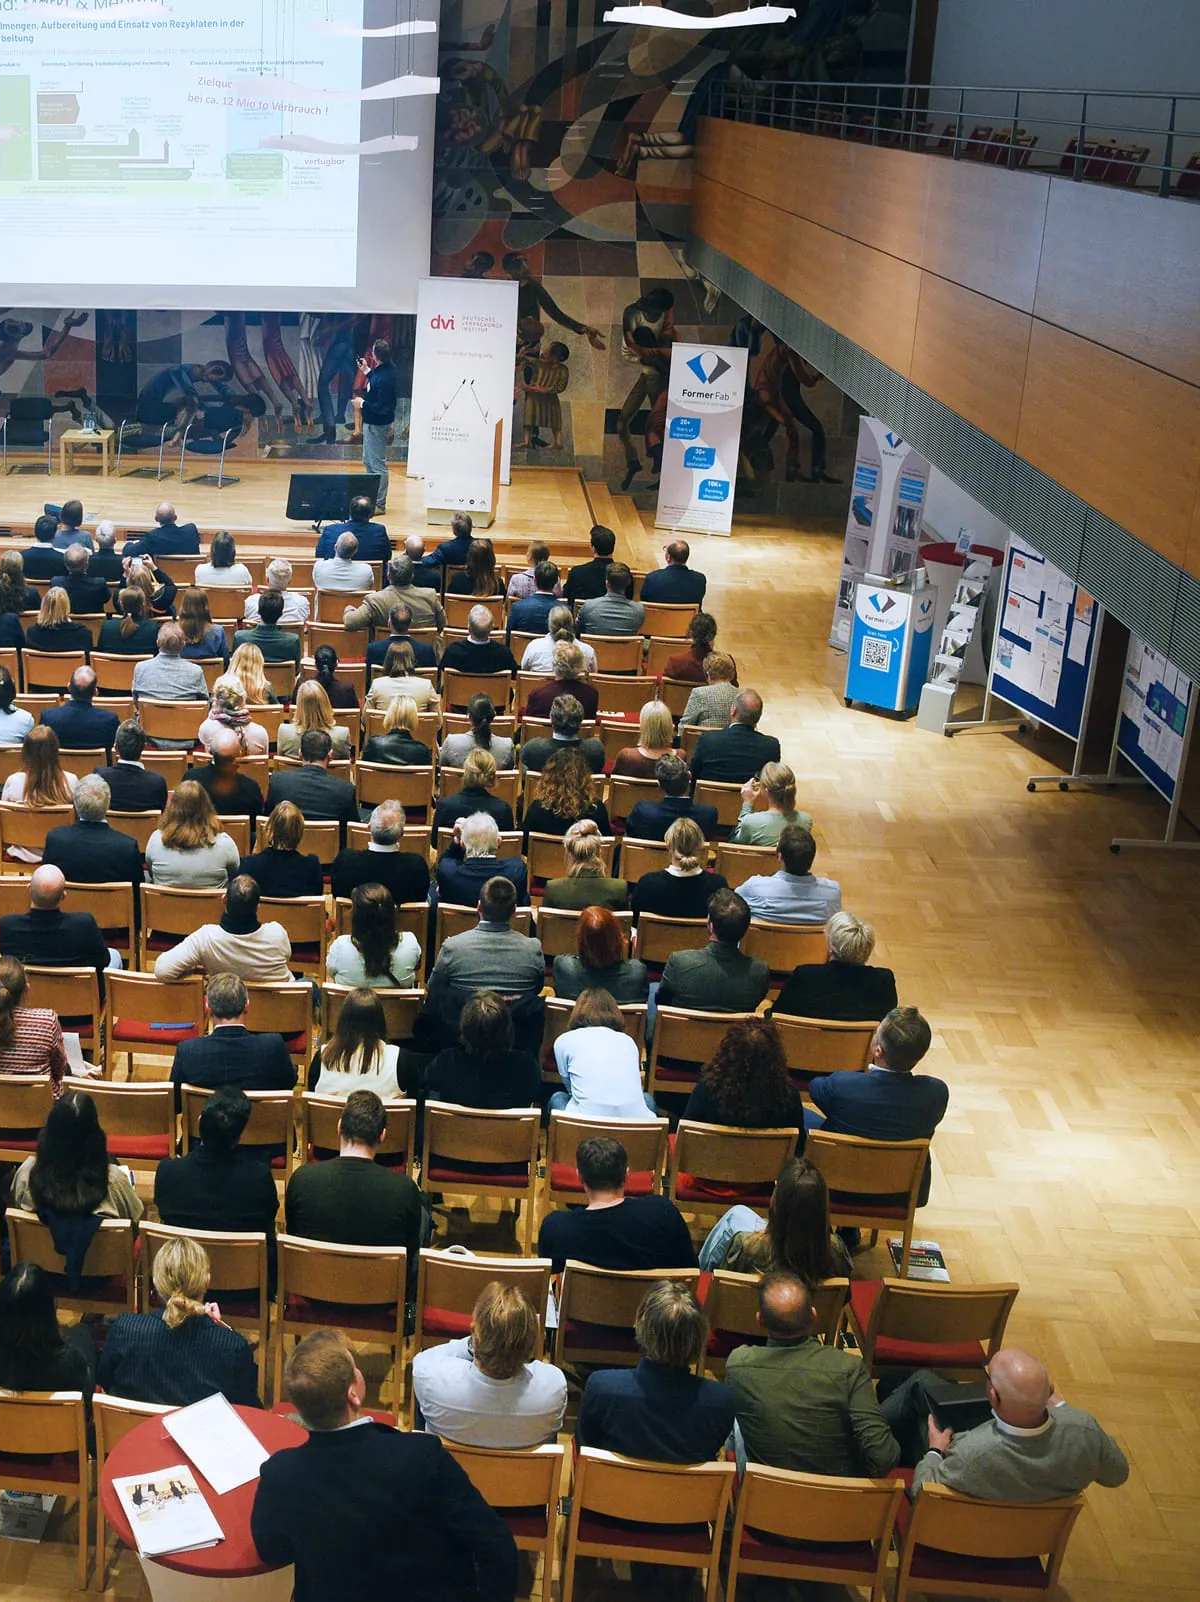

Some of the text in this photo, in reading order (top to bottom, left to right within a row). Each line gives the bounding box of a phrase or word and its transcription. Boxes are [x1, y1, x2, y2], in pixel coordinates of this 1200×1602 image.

[41, 19, 98, 31] Aufbereitung
[99, 20, 116, 29] und
[118, 19, 150, 29] Einsatz
[152, 21, 168, 29] von
[170, 18, 217, 30] Rezyklaten
[220, 18, 228, 28] in
[230, 18, 245, 28] der
[188, 92, 203, 103] bei
[205, 94, 219, 105] ca.
[222, 96, 234, 107] 12
[236, 97, 256, 109] Mio
[258, 100, 269, 110] to
[272, 101, 322, 116] Verbrauch
[430, 313, 455, 331] dvi
